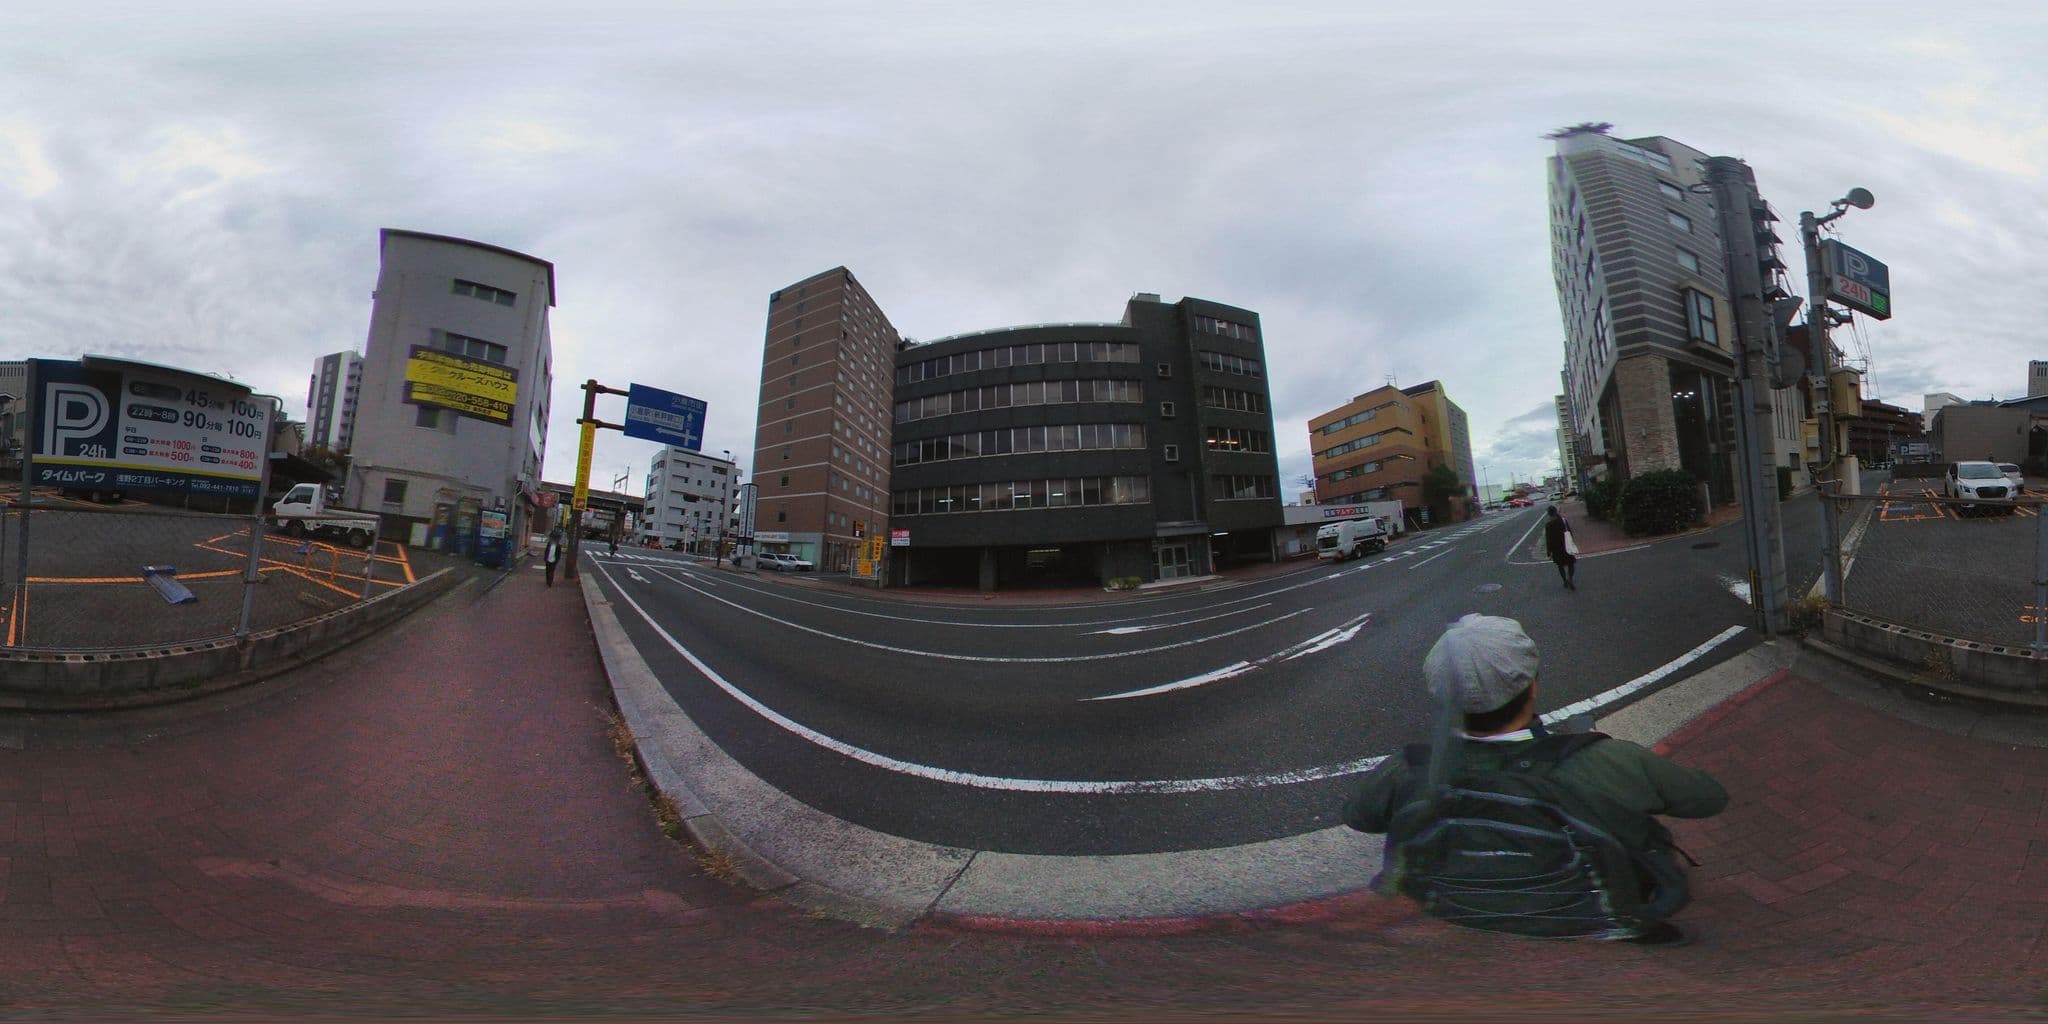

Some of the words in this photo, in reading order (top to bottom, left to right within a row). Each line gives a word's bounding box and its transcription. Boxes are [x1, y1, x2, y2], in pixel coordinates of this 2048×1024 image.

[1842, 249, 1869, 280] P
[1840, 278, 1868, 303] 24h
[43, 382, 110, 457] P
[231, 400, 264, 421] 100円
[183, 411, 223, 432] 90分毎
[227, 419, 262, 440] 100円
[79, 444, 107, 459] 24h
[41, 469, 106, 483] タイムパーク
